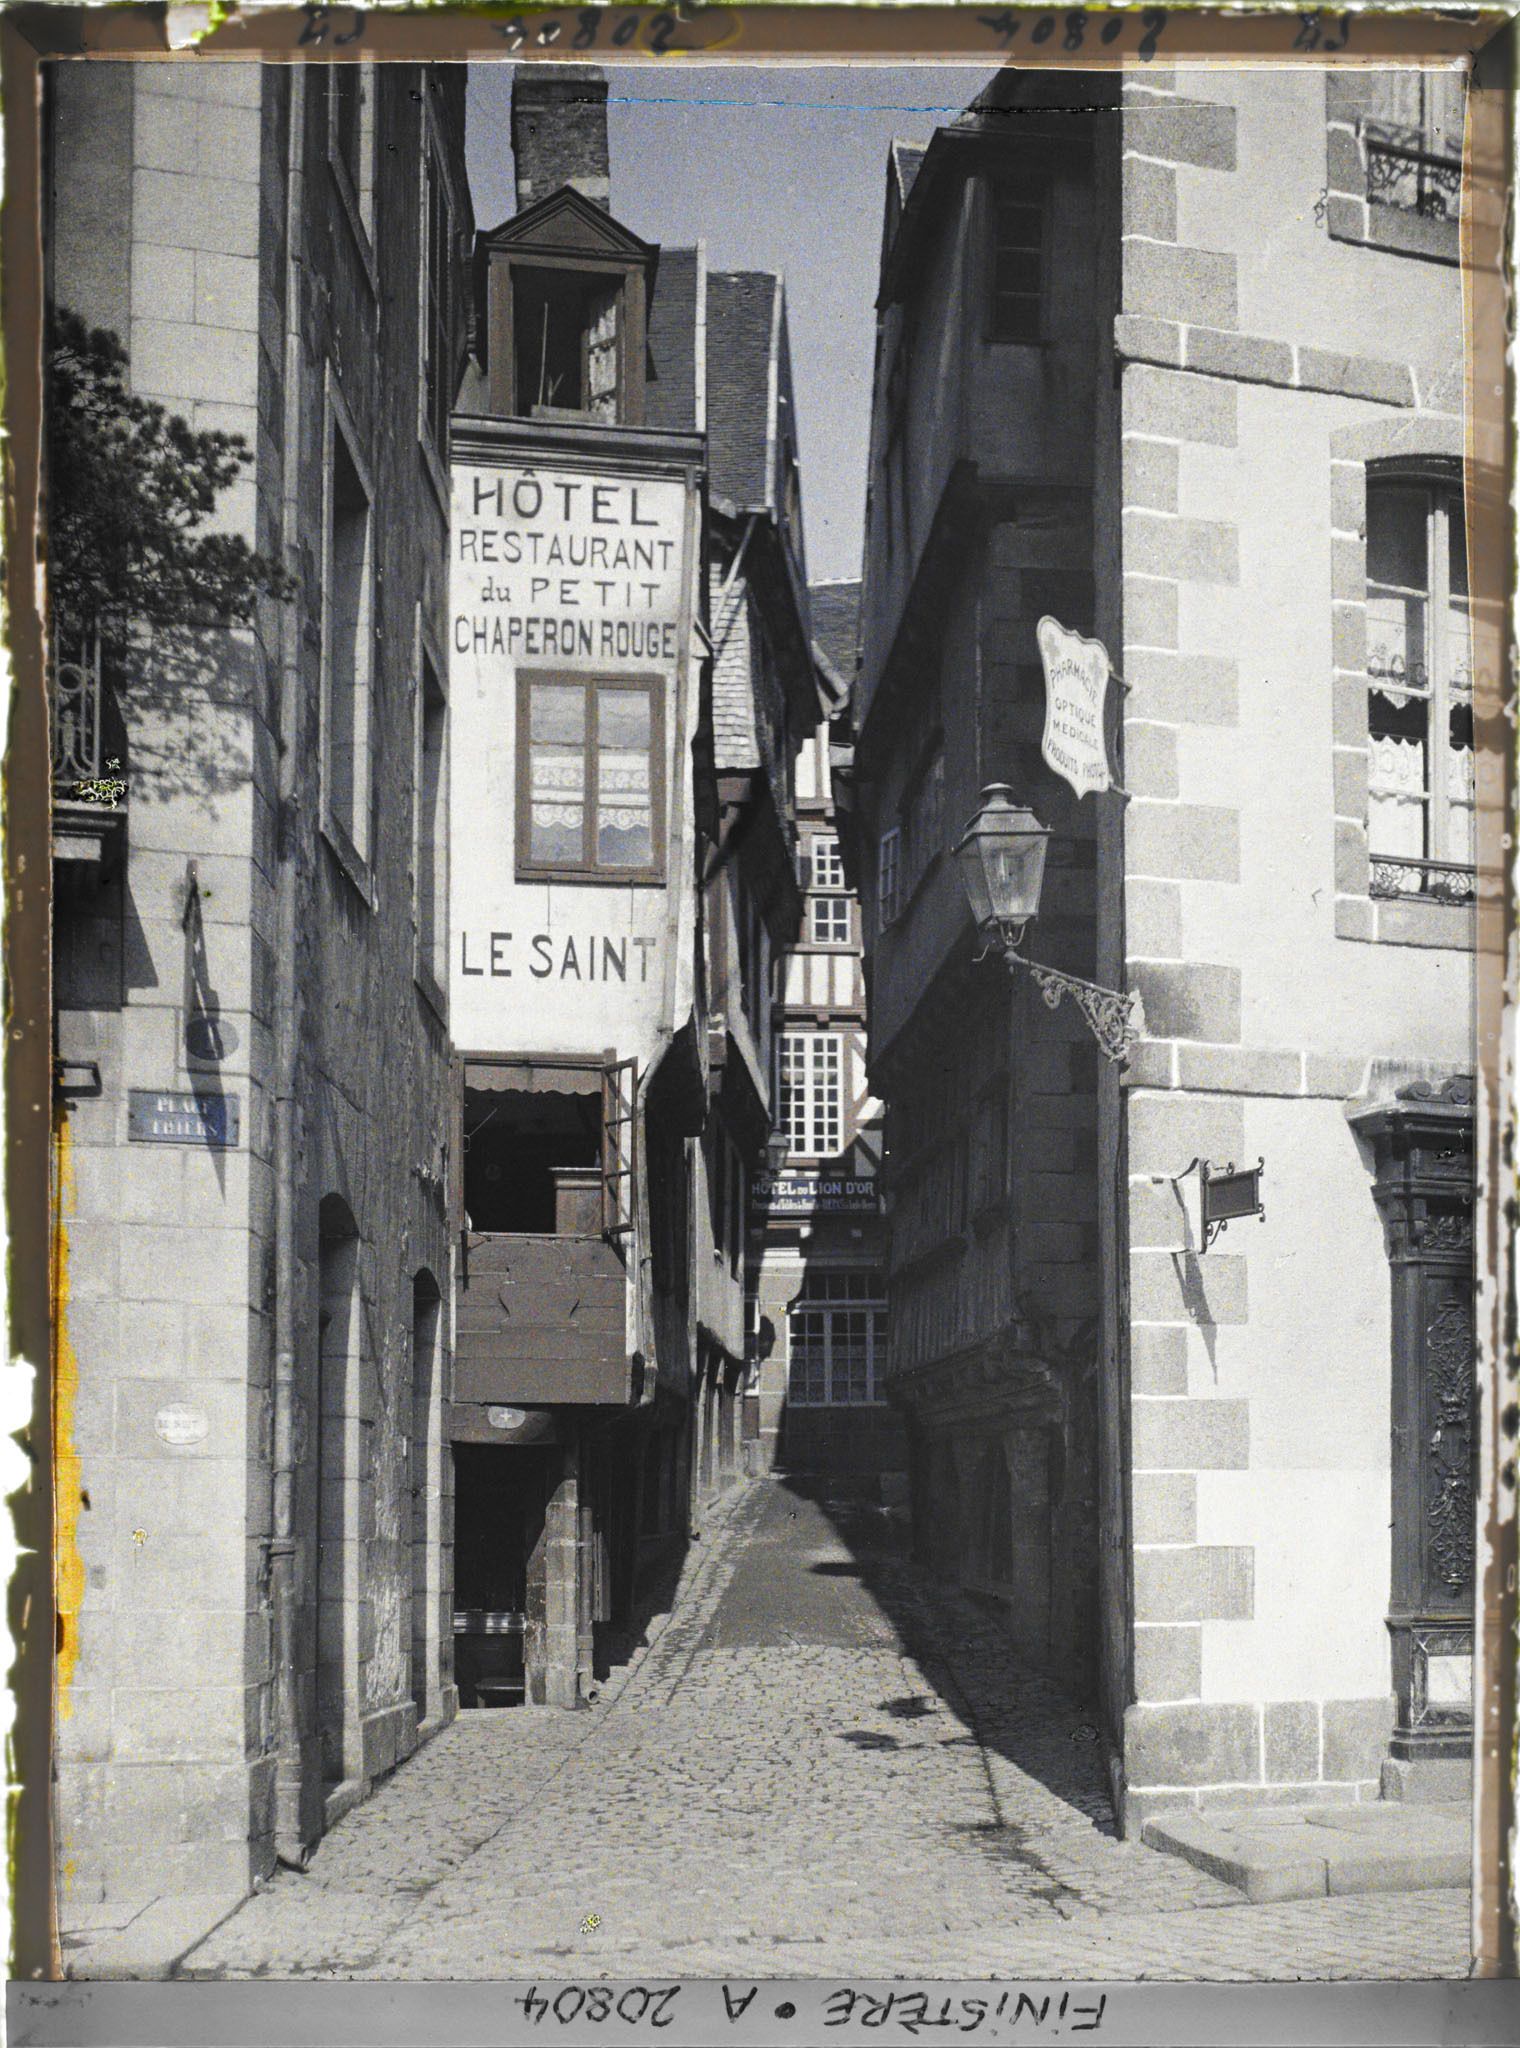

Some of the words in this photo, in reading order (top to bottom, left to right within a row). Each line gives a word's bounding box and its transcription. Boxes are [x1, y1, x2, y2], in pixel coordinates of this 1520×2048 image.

[473, 469, 659, 526] HÔTEL
[460, 529, 674, 570] RESTAURANT
[481, 576, 511, 602] du
[531, 577, 660, 607] PETIT
[455, 615, 593, 656] CHAPERON
[601, 621, 677, 659] ROUGE
[1055, 697, 1096, 728] OPTIQUE
[462, 931, 512, 977] LE
[529, 934, 656, 982] SAINT
[809, 1181, 842, 1196] LION
[846, 1181, 876, 1197] D'OR
[514, 1985, 681, 2029] 20804
[722, 1985, 759, 2018] A
